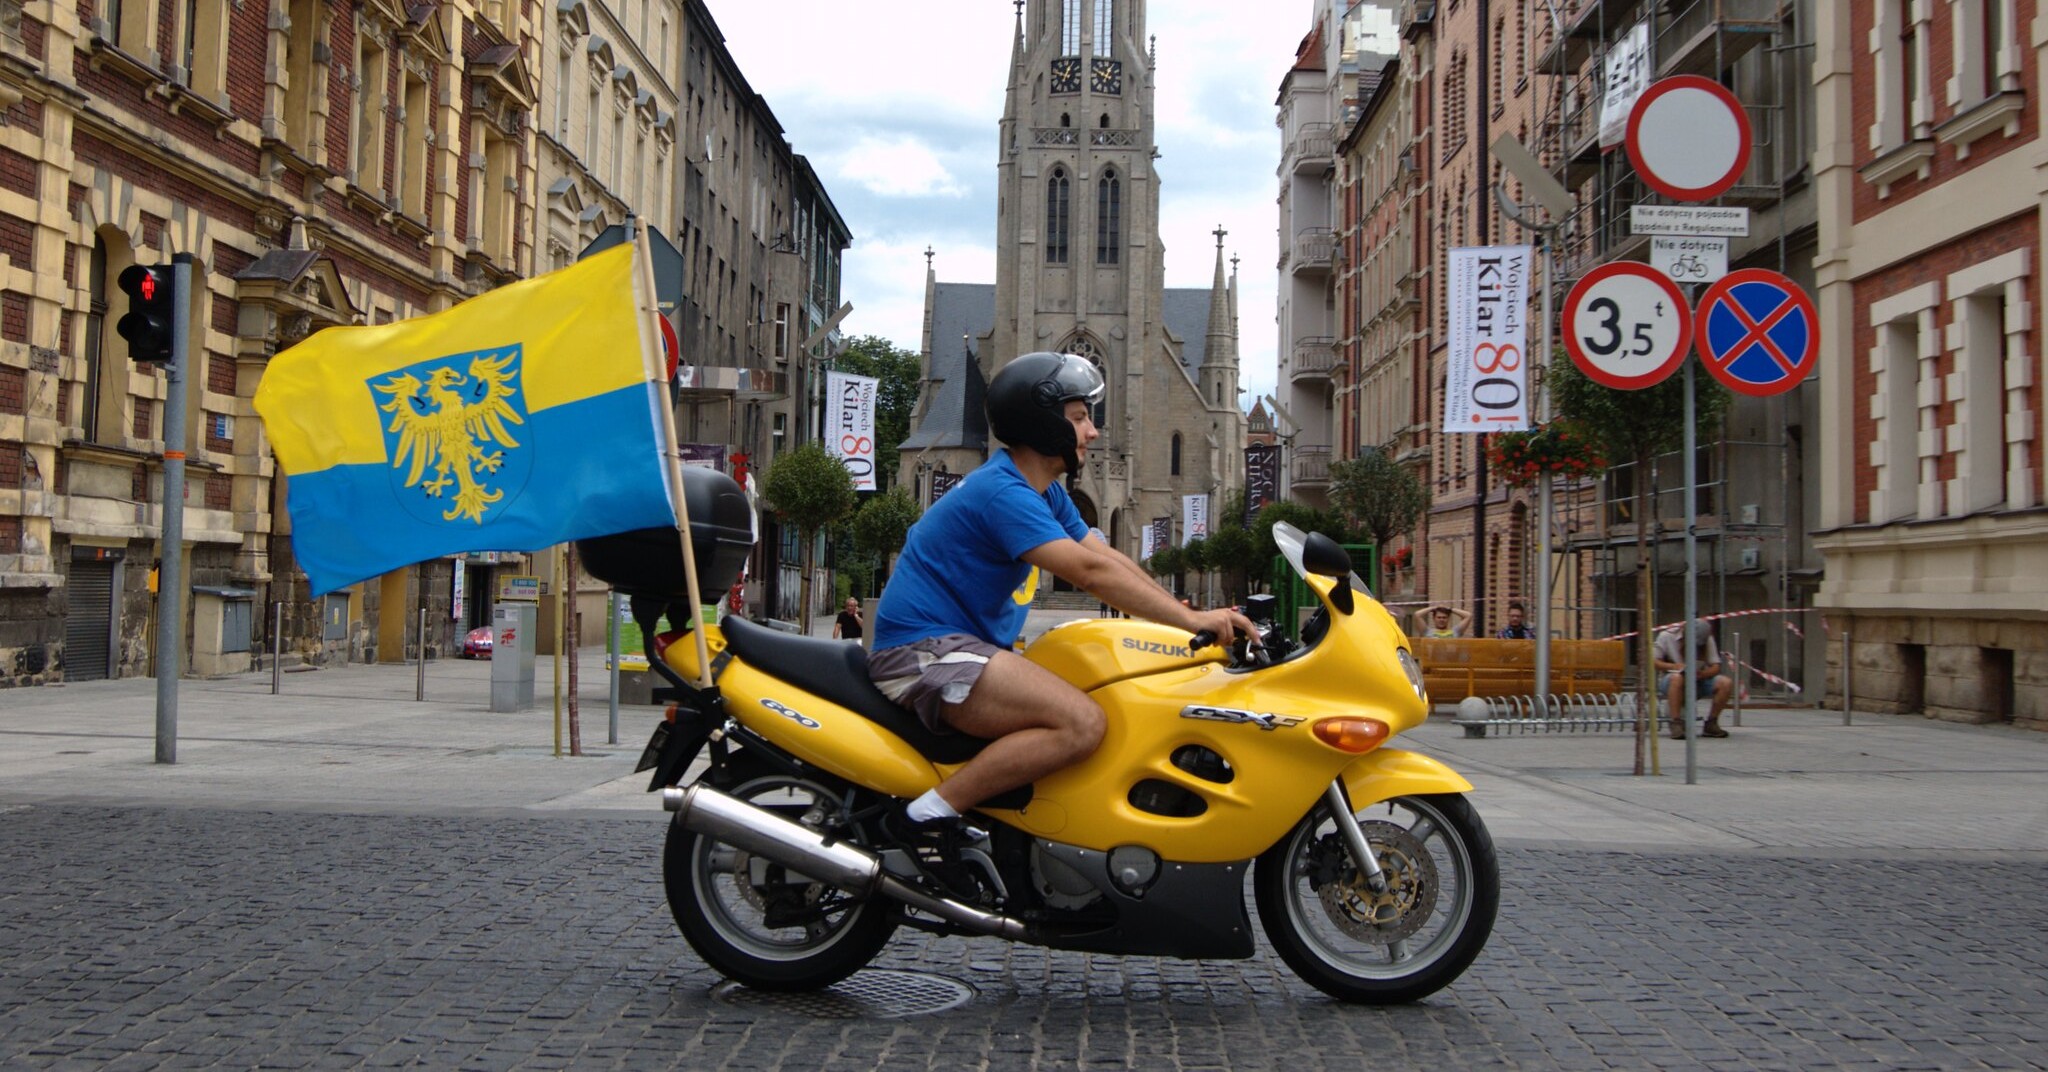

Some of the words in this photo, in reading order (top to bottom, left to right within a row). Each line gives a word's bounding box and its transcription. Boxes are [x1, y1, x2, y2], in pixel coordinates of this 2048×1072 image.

[1638, 208, 1654, 217] Nie
[1658, 209, 1693, 218] dotyczy
[1634, 223, 1671, 232] zgodnie
[1683, 223, 1745, 234] Regulaminem
[1655, 240, 1675, 250] Nie
[1680, 241, 1724, 253] dotyczy
[1477, 256, 1502, 337] Kilar
[1503, 255, 1523, 336] Wojciech
[1654, 301, 1664, 318] t
[1471, 342, 1521, 424] 80!
[843, 380, 860, 432] Kilar
[860, 383, 873, 431] Wojciech
[1191, 497, 1200, 521] Kilar
[1122, 637, 1196, 658] SUZUKI
[760, 699, 820, 729] 600
